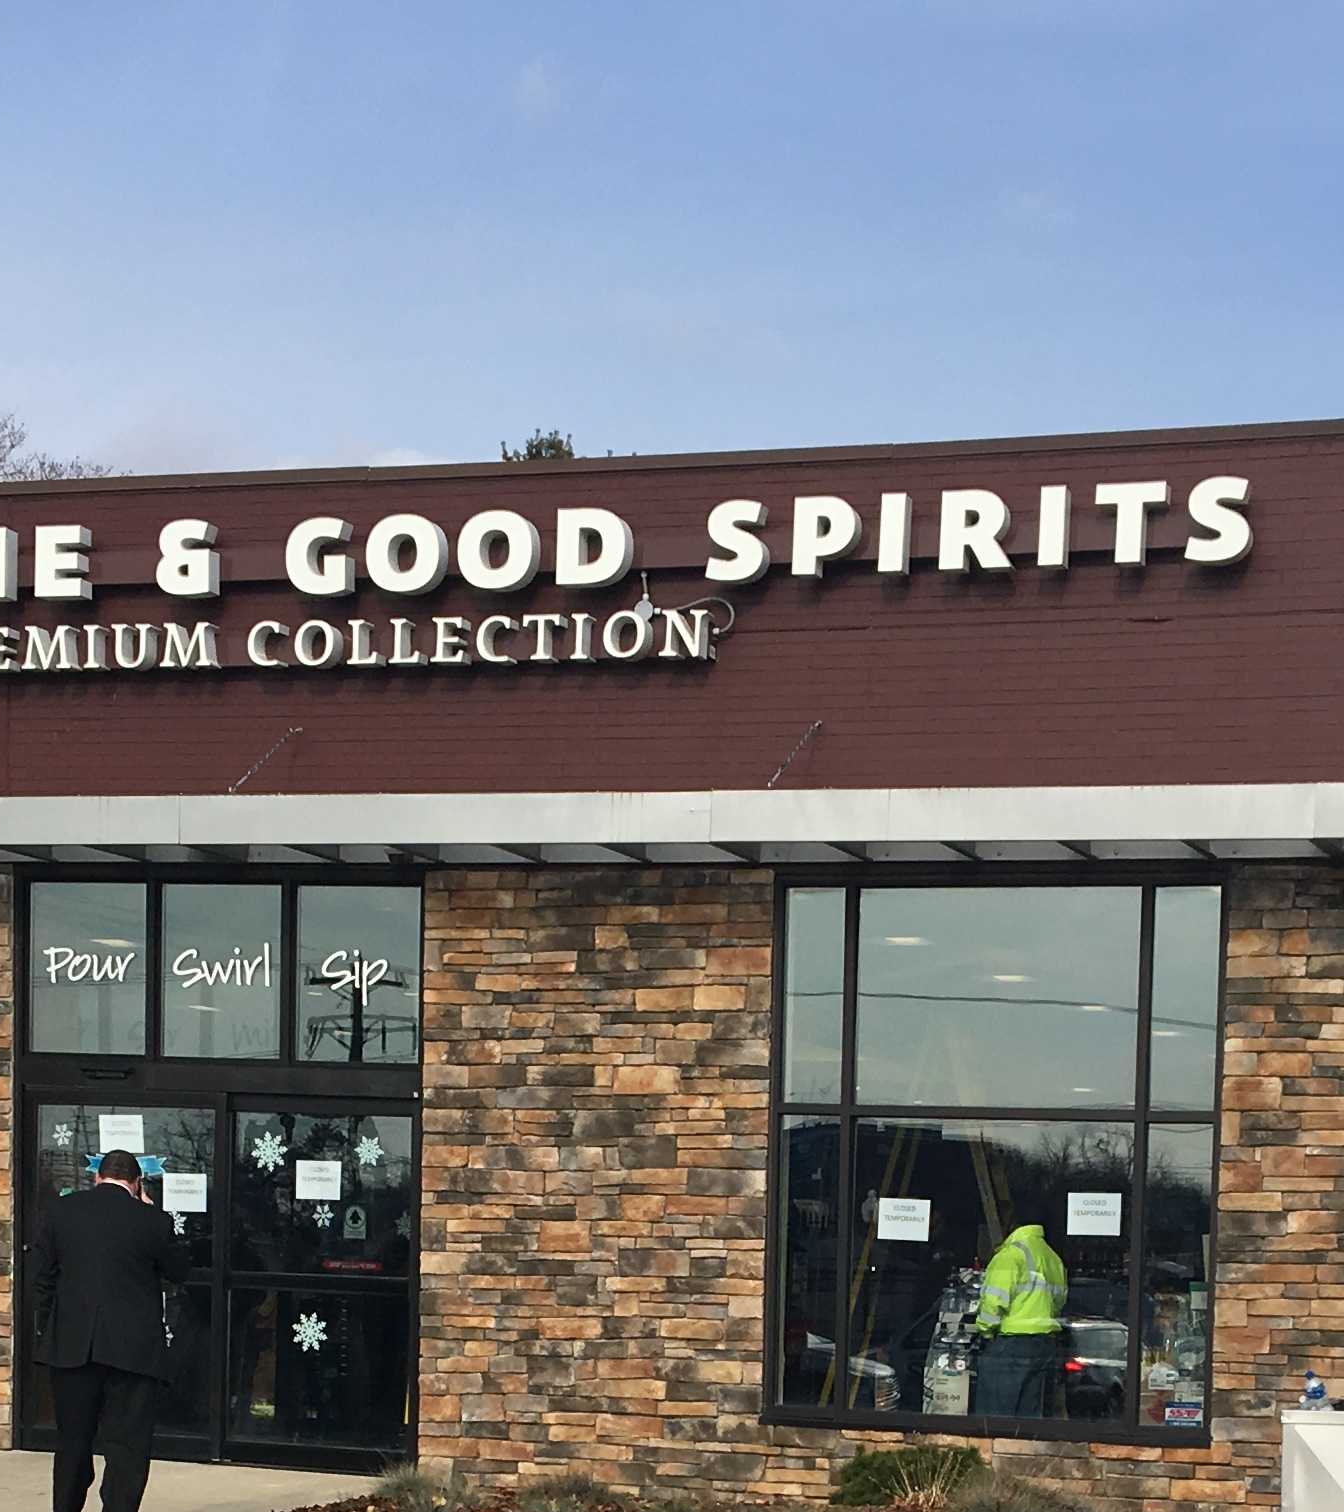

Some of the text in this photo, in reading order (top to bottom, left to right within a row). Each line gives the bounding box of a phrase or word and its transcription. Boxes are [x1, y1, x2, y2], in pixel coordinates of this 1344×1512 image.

[155, 518, 221, 597] &
[285, 507, 634, 596] GOOD
[704, 475, 1253, 582] SPIRITS
[247, 608, 710, 667] COLLECTION
[42, 942, 389, 1007] Pour Swirl Sip
